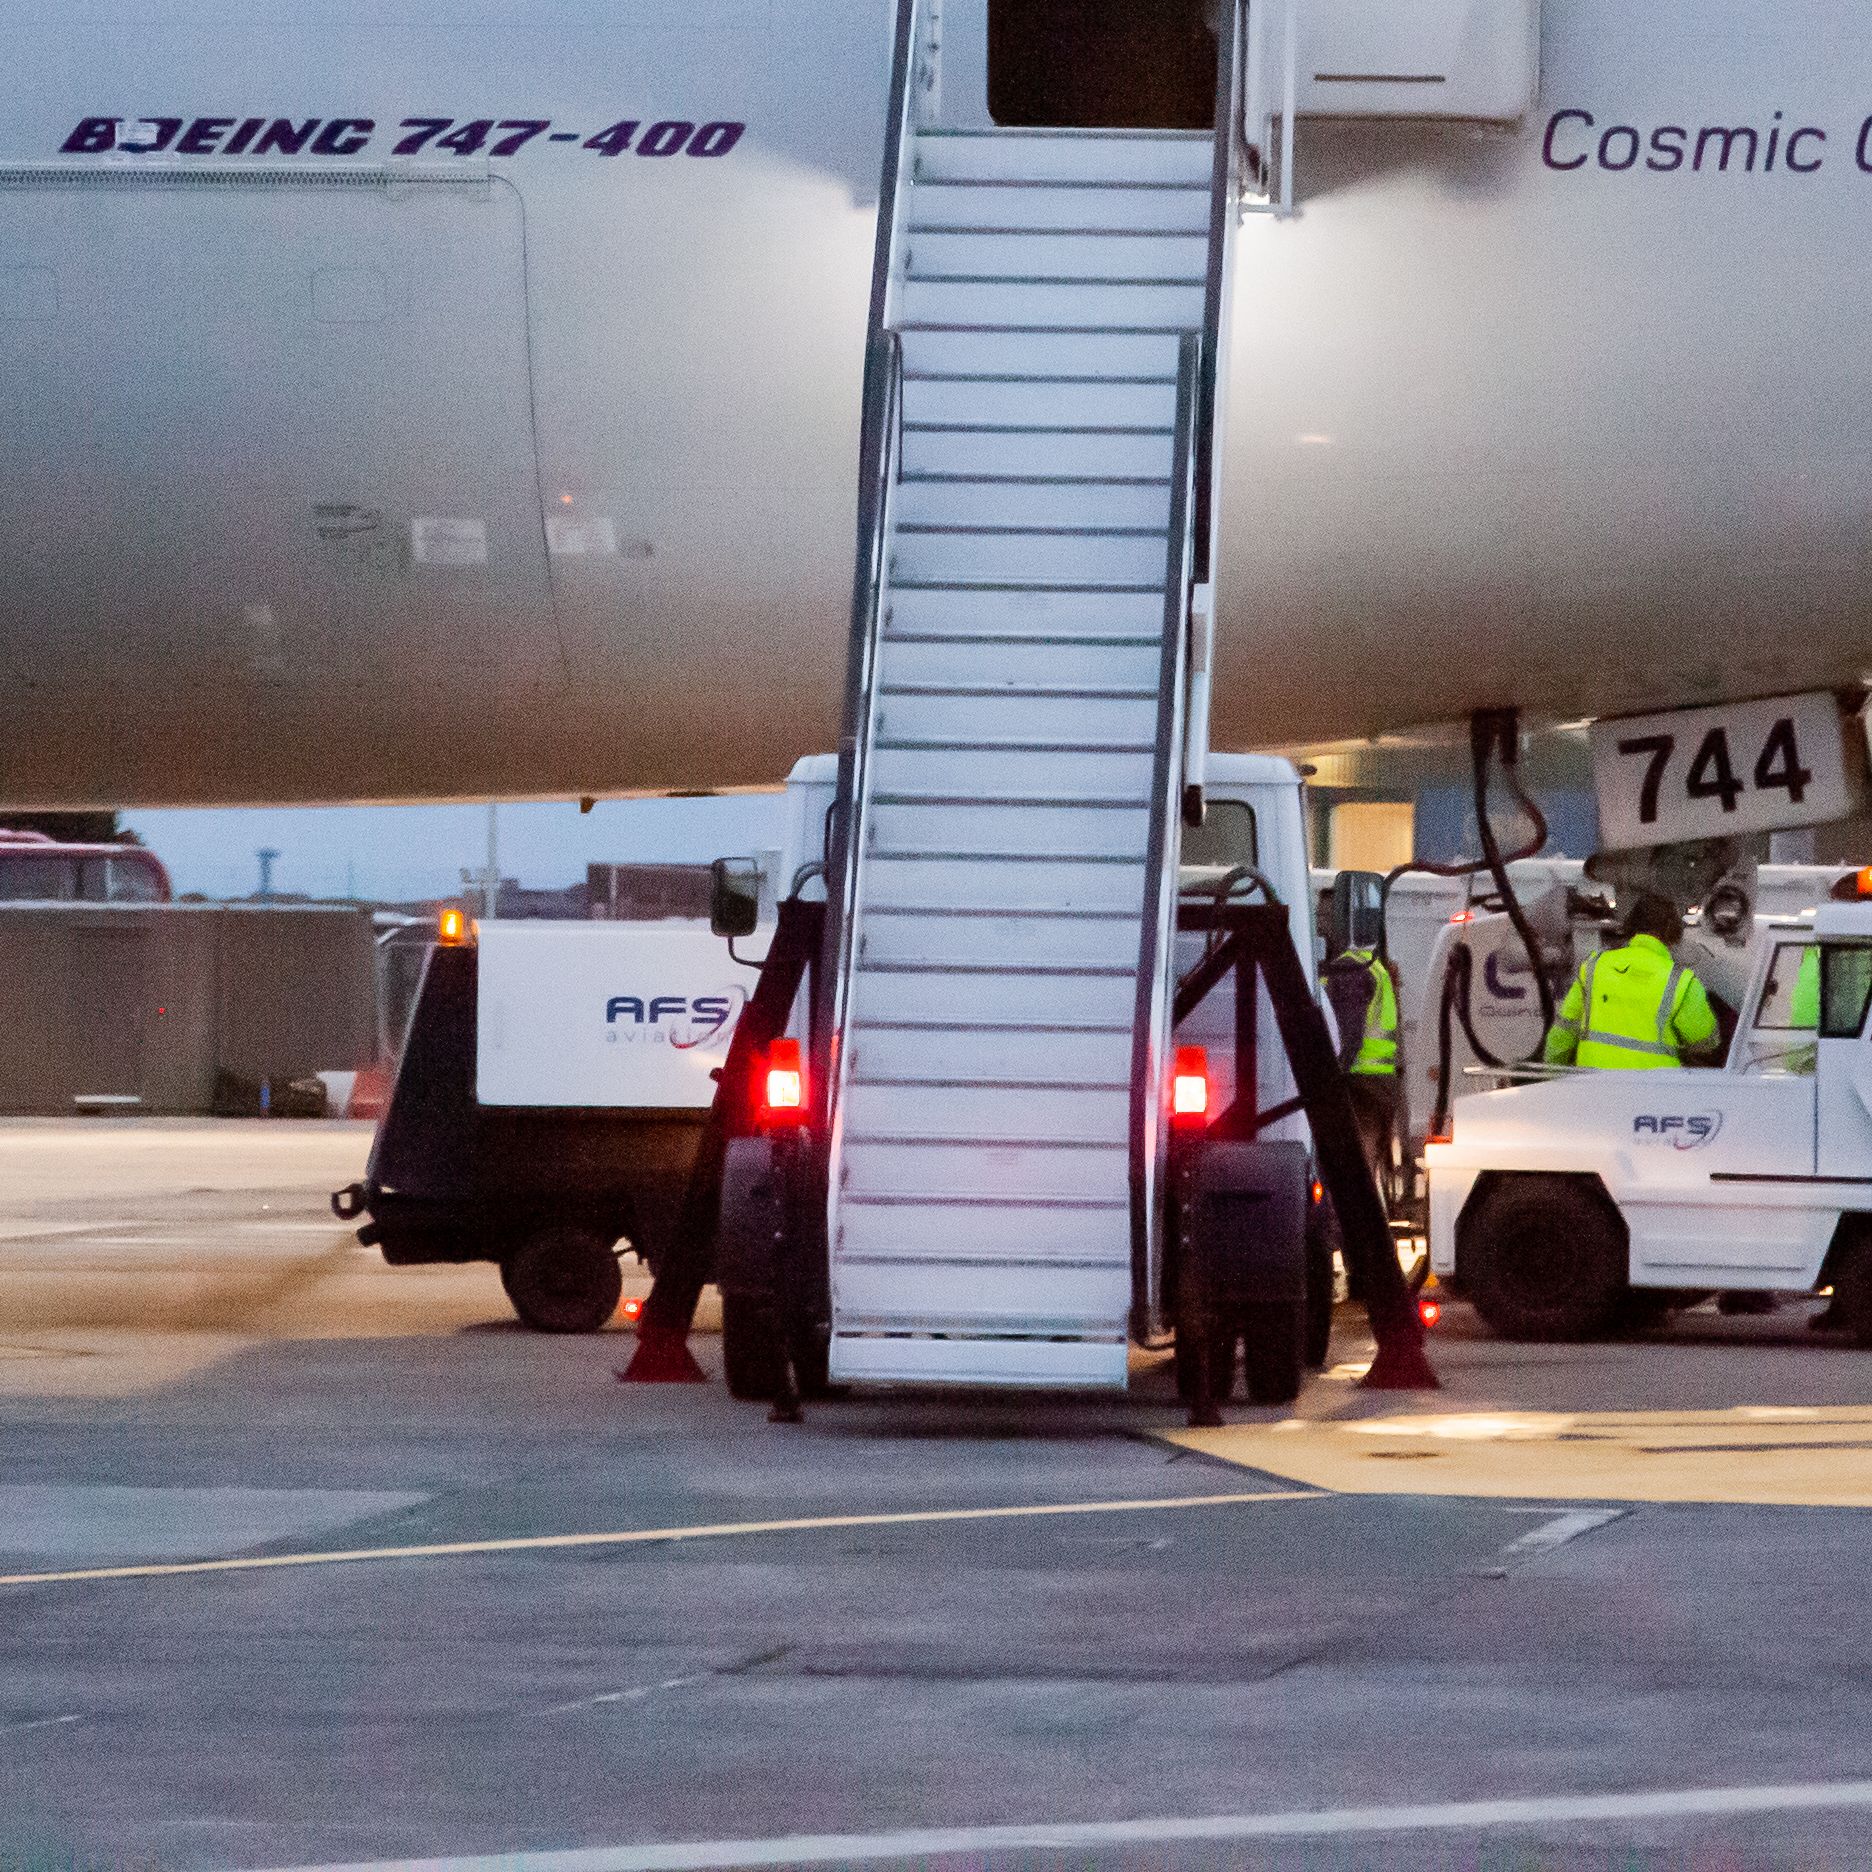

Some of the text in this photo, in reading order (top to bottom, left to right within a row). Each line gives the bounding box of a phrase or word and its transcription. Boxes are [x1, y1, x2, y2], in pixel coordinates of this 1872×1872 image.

[391, 118, 747, 158] 747-400
[1540, 108, 1827, 173] Cosmic
[1618, 717, 1812, 824] 744
[606, 996, 729, 1024] AFS
[1633, 1114, 1712, 1135] AFS
